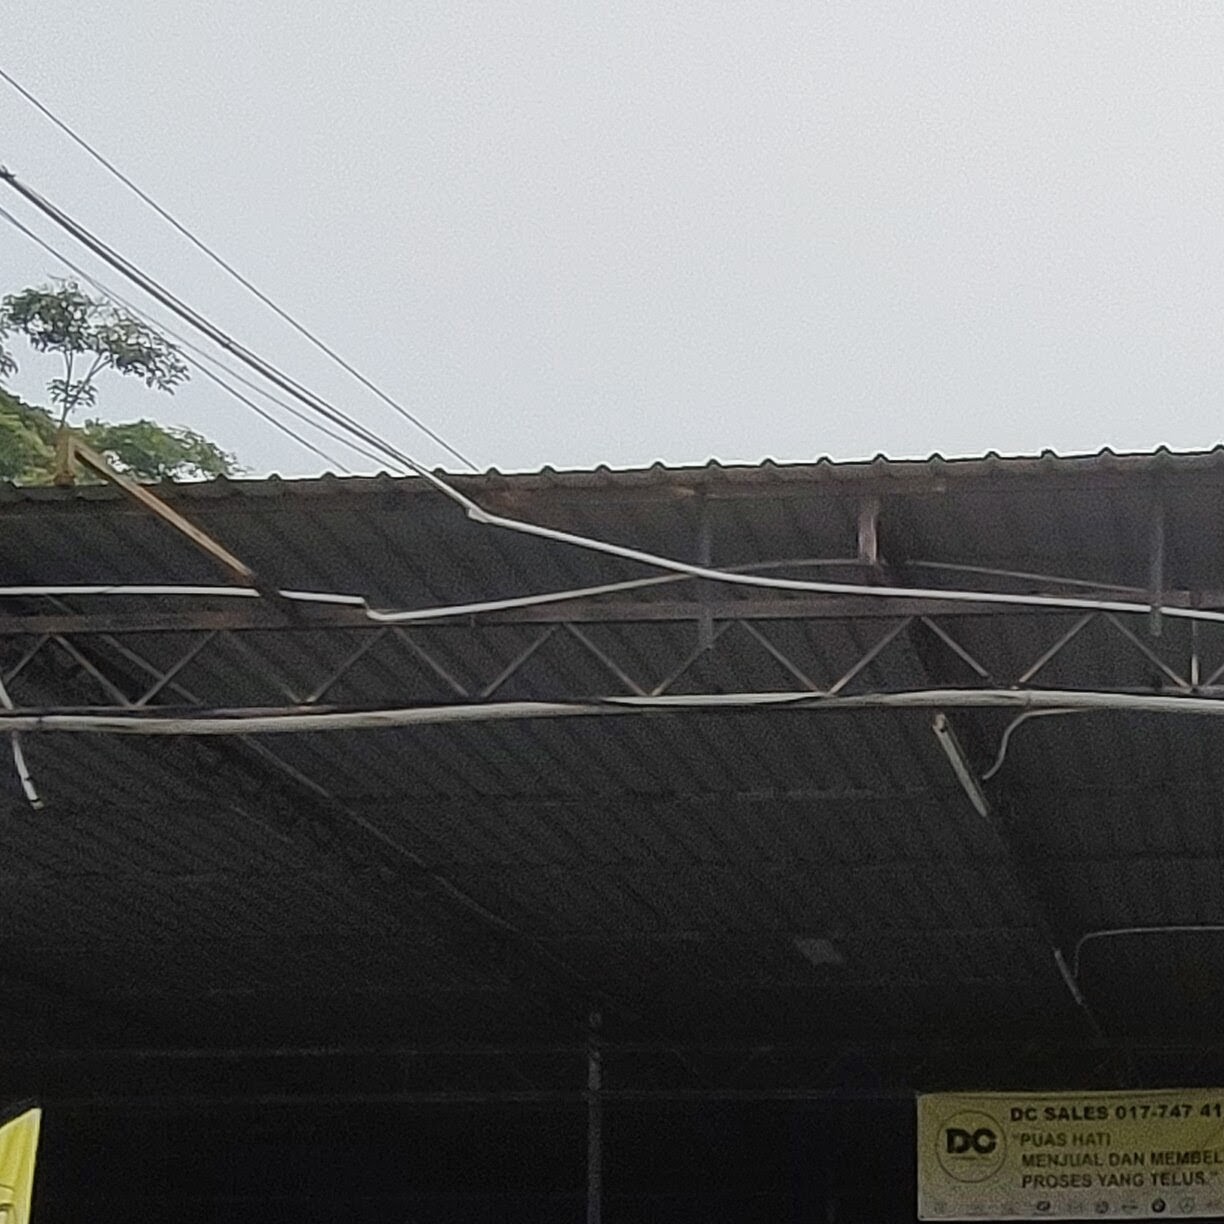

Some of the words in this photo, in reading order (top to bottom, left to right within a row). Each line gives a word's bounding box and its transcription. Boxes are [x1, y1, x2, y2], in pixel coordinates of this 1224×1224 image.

[1011, 1107, 1038, 1122] DC
[1044, 1105, 1109, 1122] SALES
[946, 1128, 997, 1154] DC
[1021, 1153, 1103, 1168] MENJUAL
[1109, 1152, 1145, 1167] DAN
[1021, 1174, 1093, 1189] PROSES
[1099, 1173, 1145, 1188] YANG
